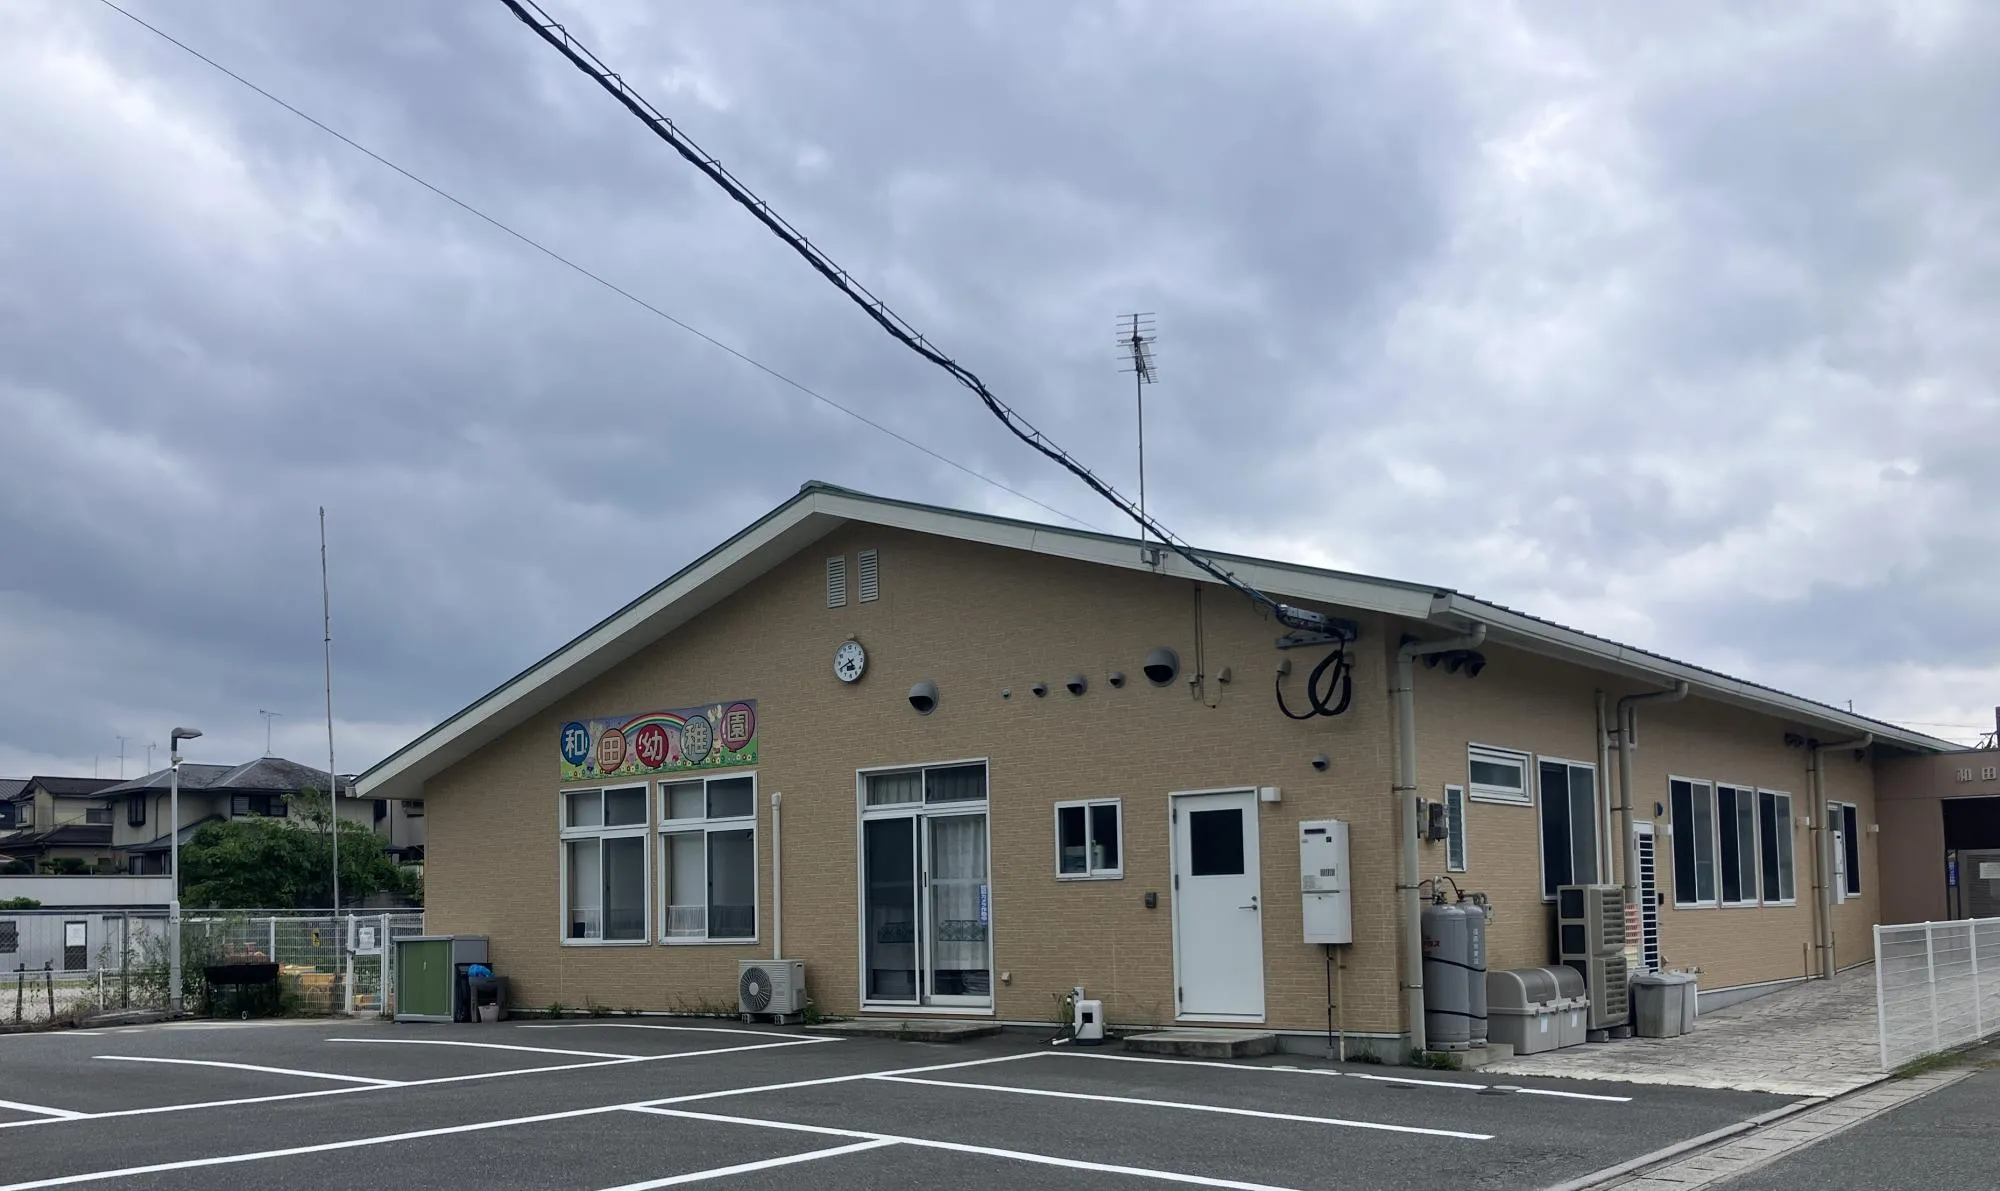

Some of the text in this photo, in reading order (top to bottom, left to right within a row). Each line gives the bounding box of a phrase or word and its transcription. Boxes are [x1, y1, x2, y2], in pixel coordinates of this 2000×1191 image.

[566, 710, 749, 764] 和田幼稚園
